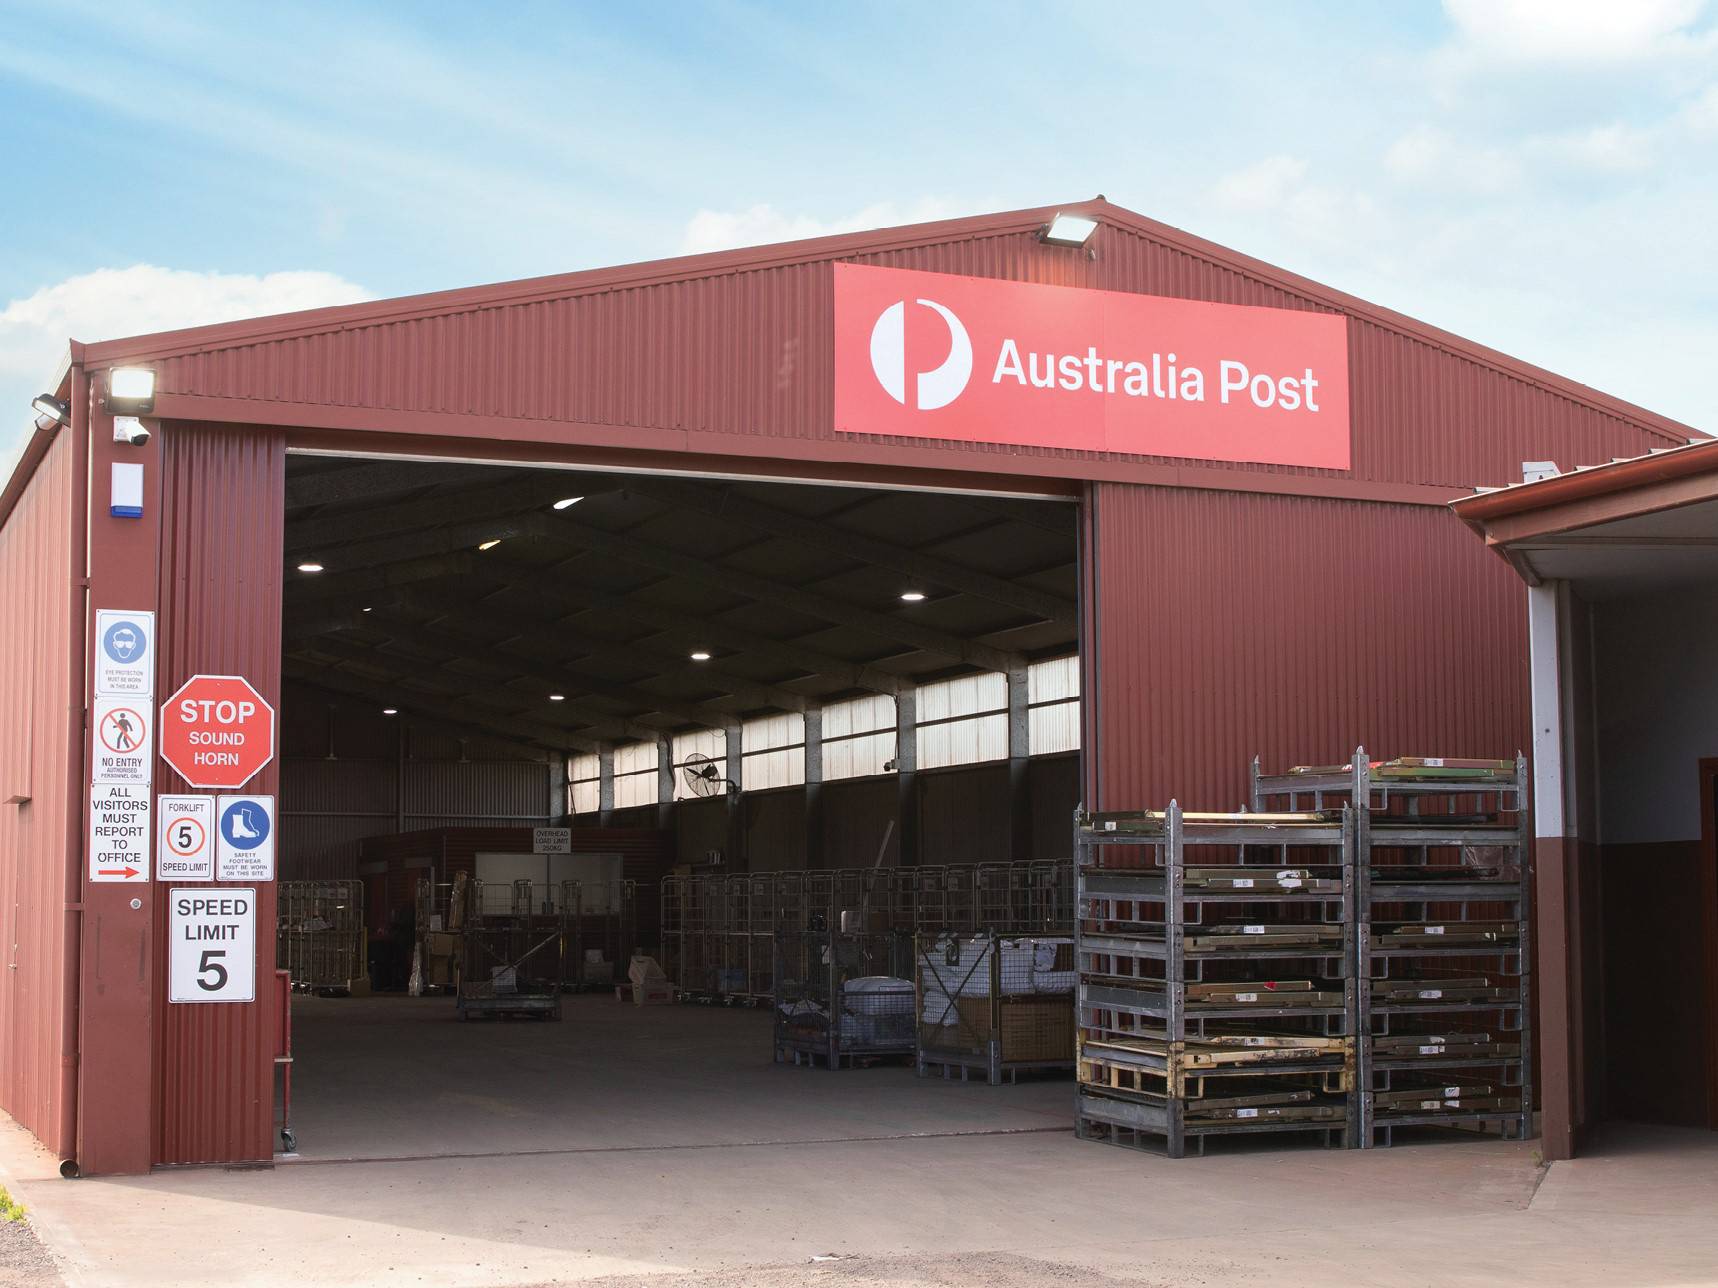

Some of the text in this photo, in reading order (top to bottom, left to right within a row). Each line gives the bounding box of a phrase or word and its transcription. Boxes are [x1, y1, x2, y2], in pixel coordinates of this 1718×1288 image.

[992, 339, 1320, 412] Australia Post
[180, 700, 255, 724] STOP
[189, 732, 244, 745] SOUND
[116, 758, 142, 766] ENTRY
[194, 752, 239, 766] HORN
[110, 788, 131, 797] ALL
[93, 800, 148, 810] VISITORS
[169, 803, 204, 812] FORKLIFT
[102, 814, 136, 823] MUST
[96, 827, 144, 836] REPORT
[178, 826, 192, 848] 5
[112, 840, 128, 849] TO
[98, 852, 141, 862] OFFICE
[163, 863, 187, 871] SPEED
[178, 899, 248, 916] SPEED
[185, 925, 239, 940] LIMIT
[197, 950, 228, 991] 5
